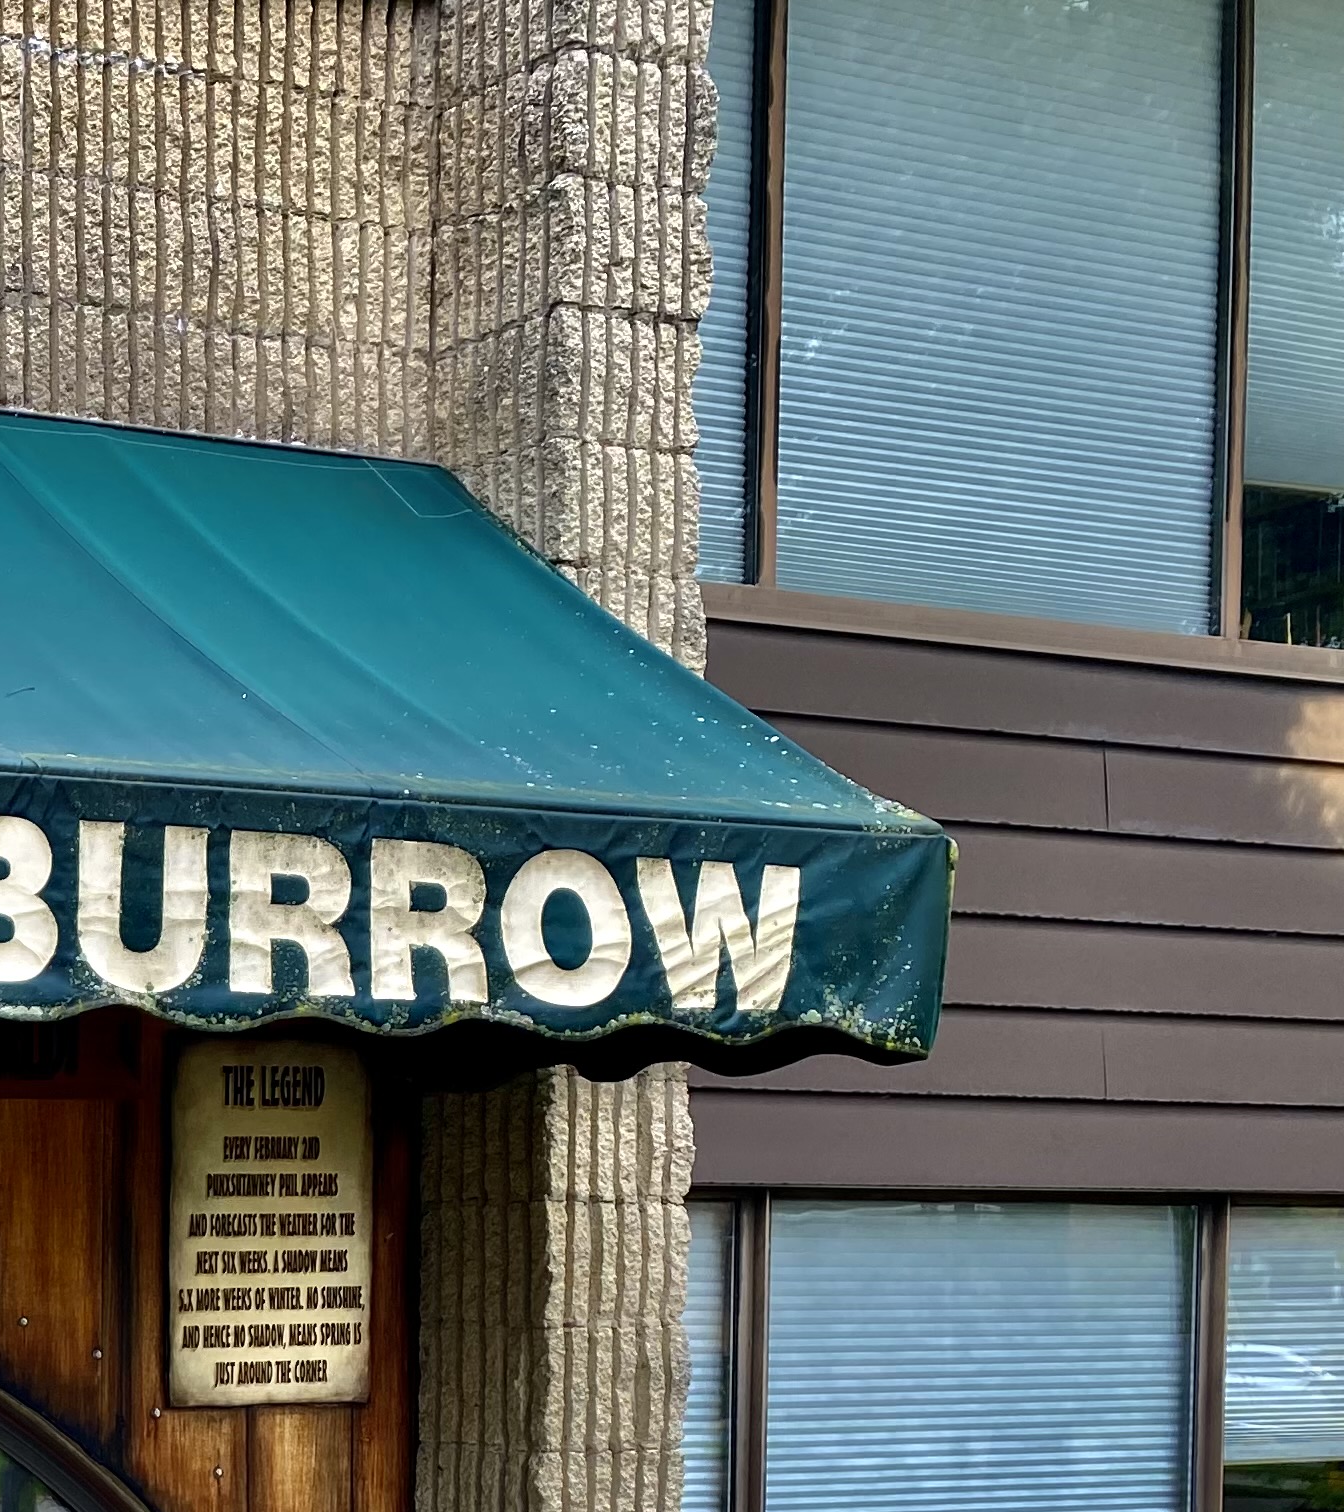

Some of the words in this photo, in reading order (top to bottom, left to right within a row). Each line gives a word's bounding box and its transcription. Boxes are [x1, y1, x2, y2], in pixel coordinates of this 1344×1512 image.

[222, 1065, 255, 1107] THE
[261, 1066, 325, 1107] LEGEND
[223, 1136, 252, 1160] EVERY
[254, 1136, 300, 1160] FEBRUARY
[302, 1136, 320, 1160] 2ND
[207, 1173, 277, 1198] PUNXSUTAWNEY
[279, 1173, 299, 1197] PHIL
[301, 1173, 339, 1197] APPEARS
[189, 1214, 207, 1237] AND
[210, 1214, 257, 1236] FORECASTS
[259, 1214, 276, 1236] THE
[279, 1213, 318, 1236] WEATHER
[320, 1213, 338, 1236] FOR
[339, 1213, 355, 1236] THE
[196, 1251, 219, 1274] NEXT
[222, 1251, 237, 1273] SIX
[238, 1251, 271, 1273] WEEKS.
[273, 1250, 279, 1273] A
[282, 1250, 318, 1273] SHADOW
[320, 1250, 348, 1272] MEANS
[196, 1288, 220, 1311] MORE
[223, 1288, 252, 1311] WEEKS
[255, 1288, 265, 1310] OF
[268, 1287, 304, 1310] WINTER.
[306, 1287, 319, 1309] NO
[321, 1286, 365, 1311] SUNSHINE,
[182, 1325, 200, 1349] AND
[203, 1325, 231, 1348] HENCE
[233, 1325, 246, 1348] NO
[248, 1324, 286, 1349] SHADOW,
[289, 1323, 317, 1346] MEANS
[320, 1323, 351, 1345] SPRING
[353, 1322, 362, 1345] IS
[215, 1362, 236, 1387] JUST
[238, 1361, 273, 1385] AROUND
[275, 1361, 291, 1383] THE
[295, 1360, 328, 1383] CORNER
